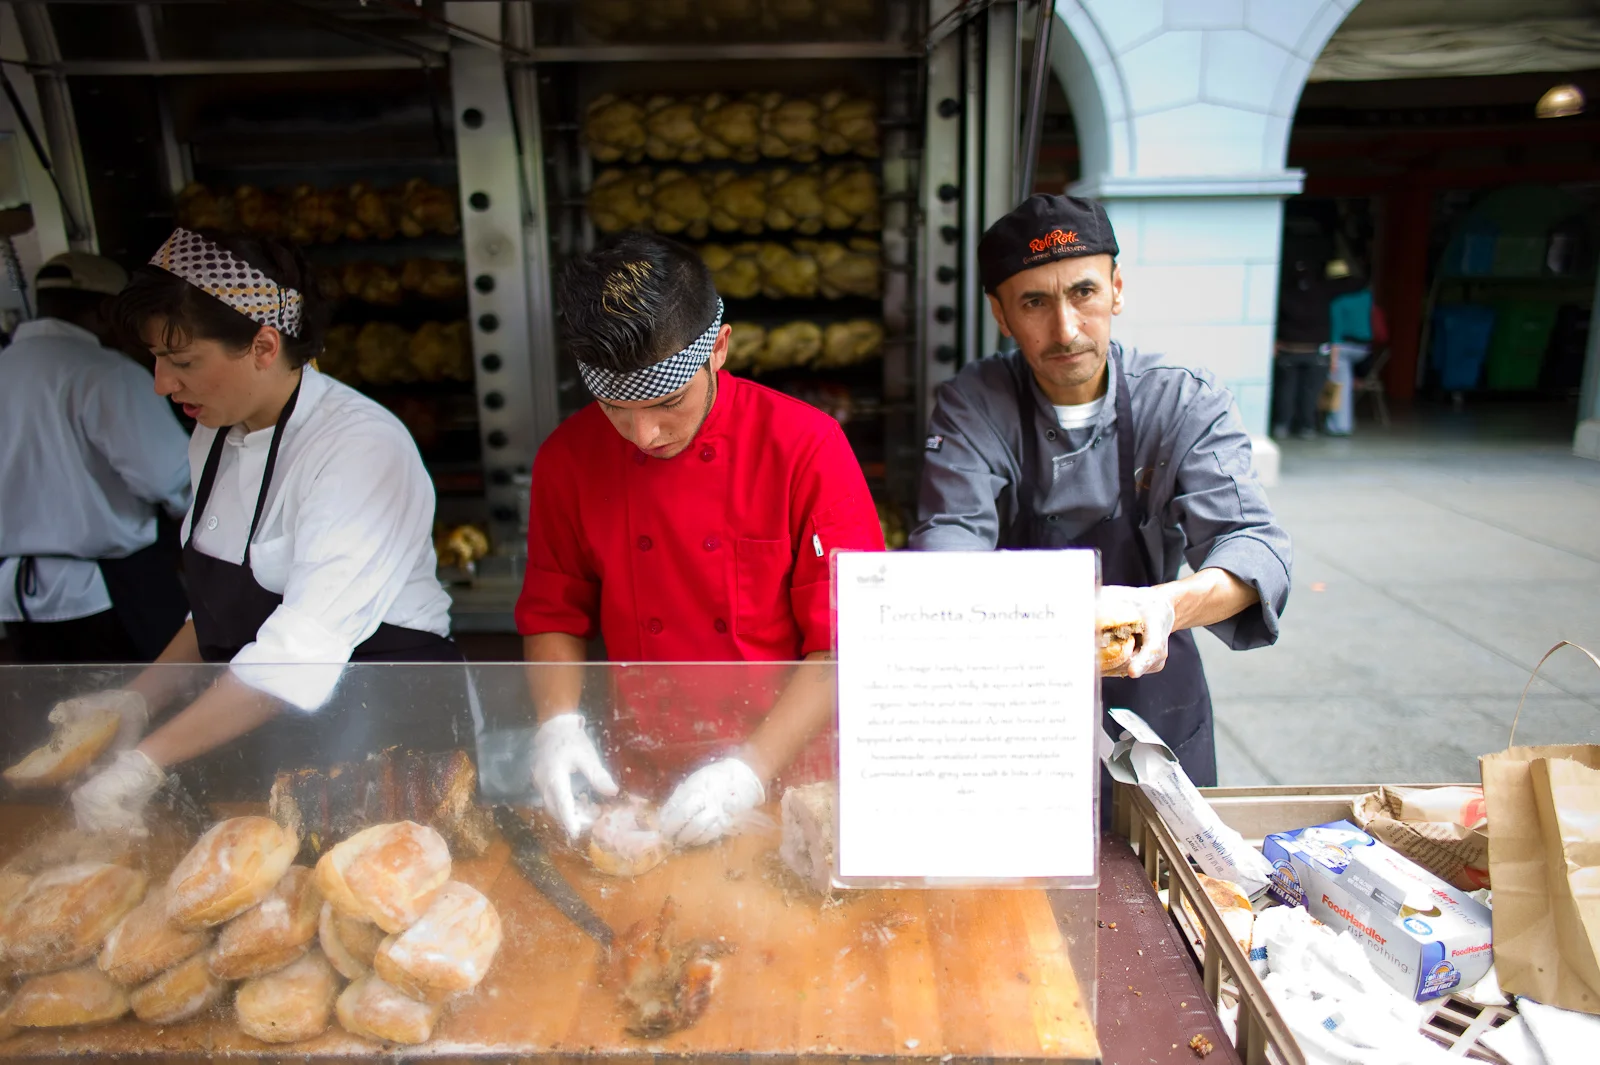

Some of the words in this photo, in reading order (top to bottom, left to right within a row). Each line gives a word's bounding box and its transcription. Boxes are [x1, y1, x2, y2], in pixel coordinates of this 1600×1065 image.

[879, 603, 964, 625] Porchetta
[968, 603, 1056, 624] Sandwich
[1185, 837, 1200, 853] LARGE
[1321, 894, 1387, 946] FoodHandler
[1347, 924, 1363, 941] risk
